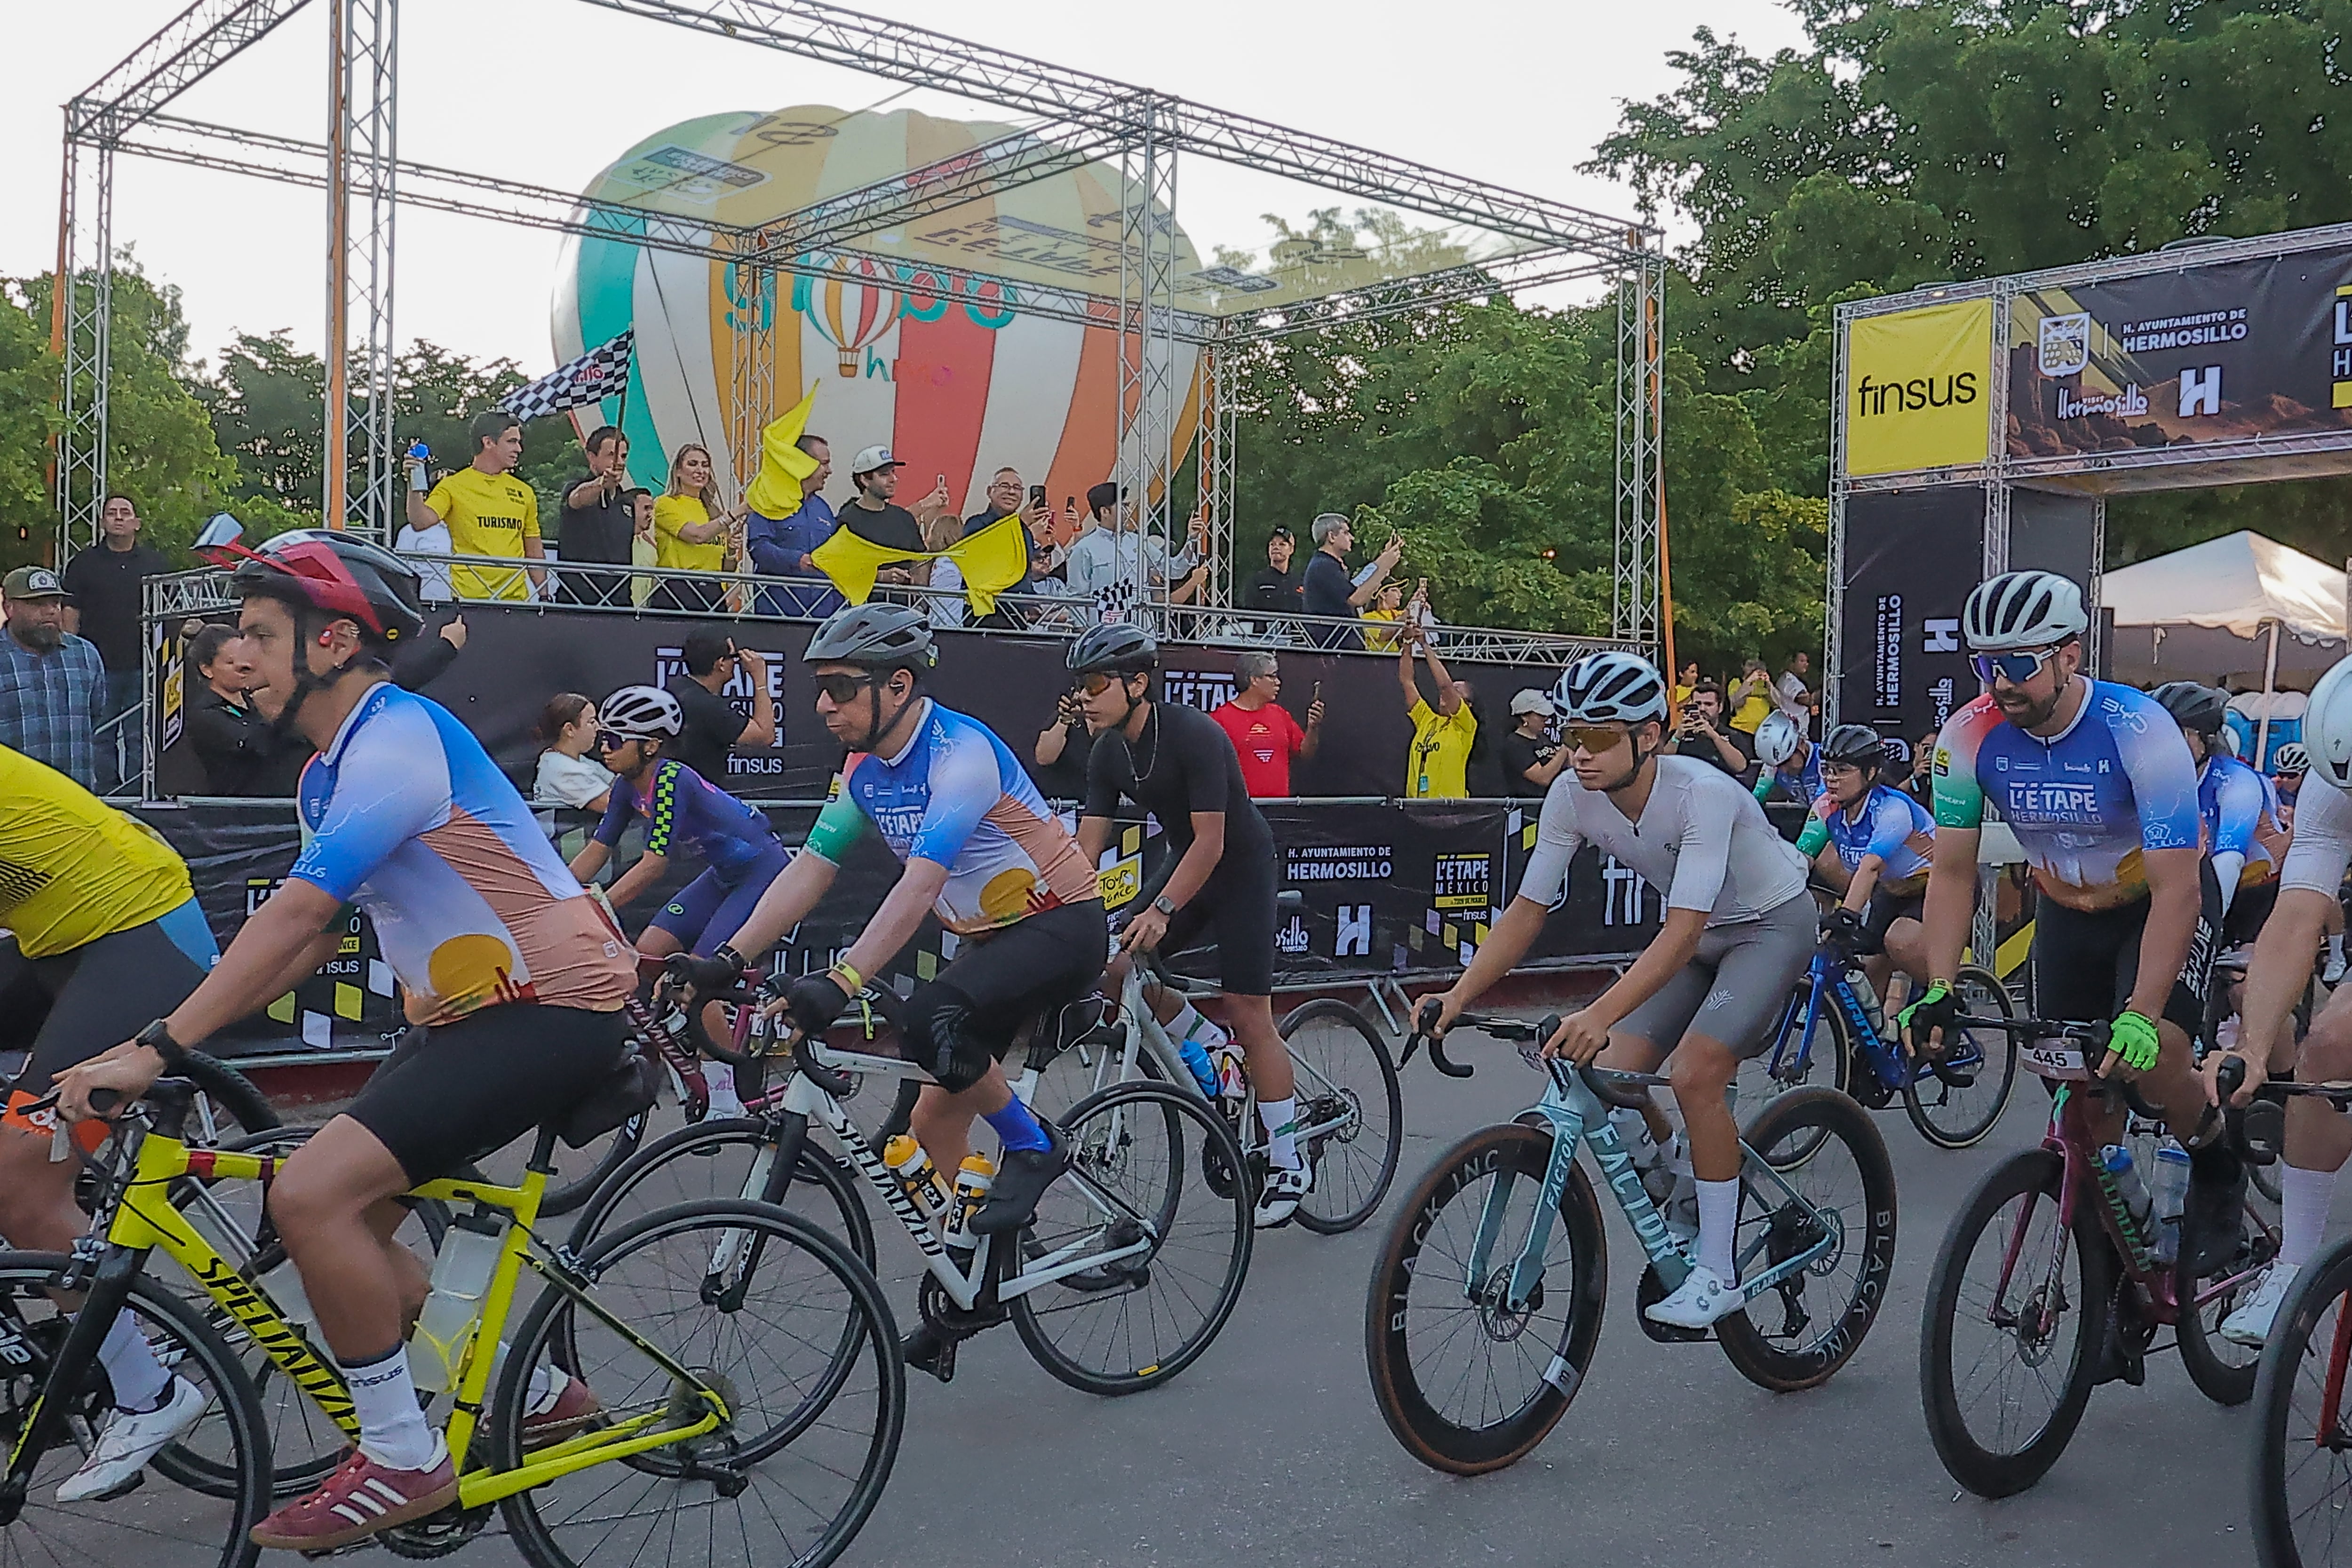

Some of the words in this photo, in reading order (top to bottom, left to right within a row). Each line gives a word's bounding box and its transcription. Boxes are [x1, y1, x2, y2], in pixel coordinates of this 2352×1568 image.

[2122, 322, 2248, 353] HERMOSILLO
[2137, 312, 2224, 333] AYUNTAMIENTO
[2229, 308, 2247, 320] DE
[1858, 372, 1977, 417] finsus
[2057, 382, 2149, 420] Hermosillo
[477, 516, 522, 531] TURISMO
[1878, 597, 1886, 611] DE
[1876, 613, 1886, 693] AYUNTAMIENTO
[1886, 595, 1901, 706] HERMOSILLO
[727, 753, 783, 774] finsus
[1287, 848, 1298, 859] H.
[1302, 846, 1376, 858] AYUNTAMIENTO
[1379, 846, 1391, 857] DE
[1287, 860, 1392, 880] HERMOSILLO
[1435, 878, 1488, 894] MÉXICO
[1436, 860, 1489, 881] L'ÉTAPE
[1463, 908, 1487, 921] finsus
[1836, 981, 1881, 1049] GIANT
[2033, 1049, 2067, 1067] 445
[1452, 1149, 1498, 1193] INC
[1546, 1129, 1576, 1211] FACTOR
[1584, 1122, 1677, 1262] FACTOR
[1391, 1197, 1442, 1332] BLACK
[1852, 1210, 1891, 1323] BLACK
[1814, 1326, 1852, 1369] INC
